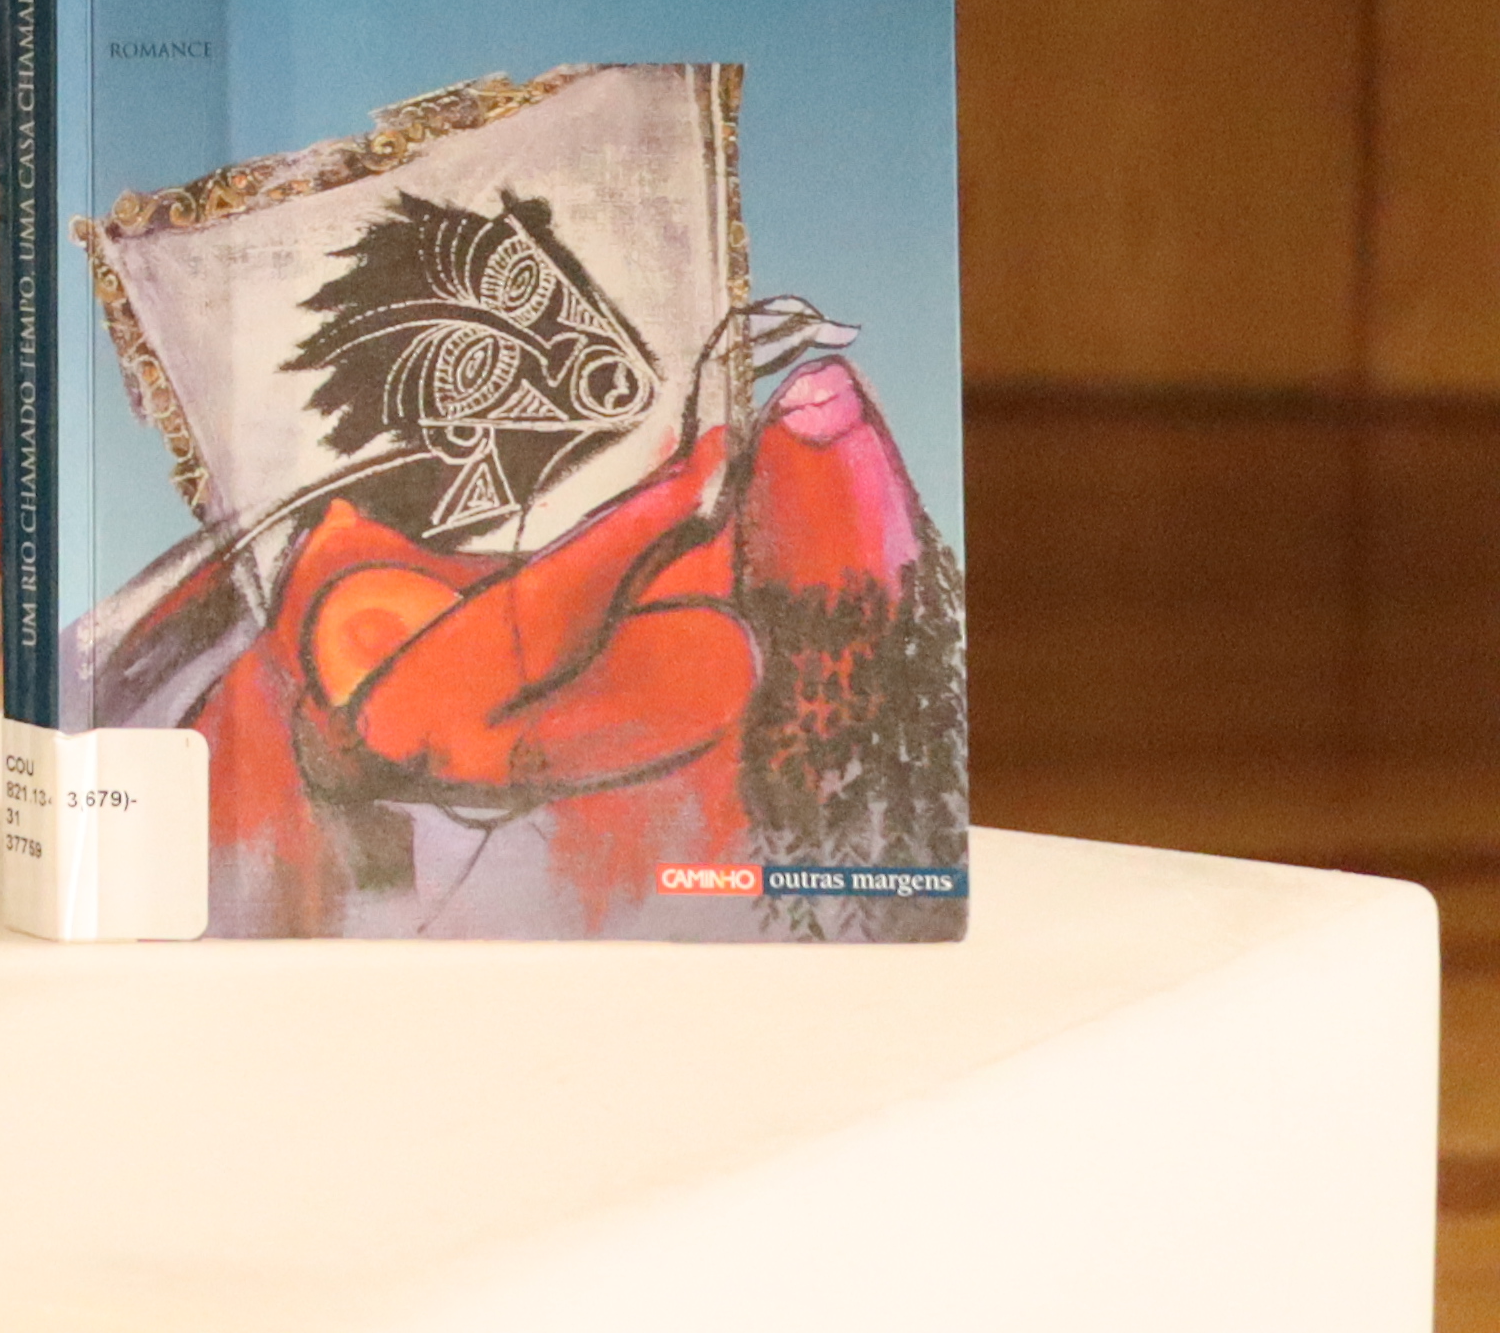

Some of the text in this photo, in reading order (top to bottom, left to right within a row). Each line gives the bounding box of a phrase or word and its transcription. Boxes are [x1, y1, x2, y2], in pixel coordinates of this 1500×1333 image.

[108, 41, 213, 60] ROMANCE
[17, 121, 36, 190] CASA
[18, 198, 36, 260] UMA
[19, 381, 37, 534] CHAMADO
[20, 540, 37, 593] RIO
[22, 603, 37, 647] UM
[6, 754, 34, 777] COU
[6, 807, 20, 826] 31
[661, 868, 954, 897] CAMINHO outras margens
